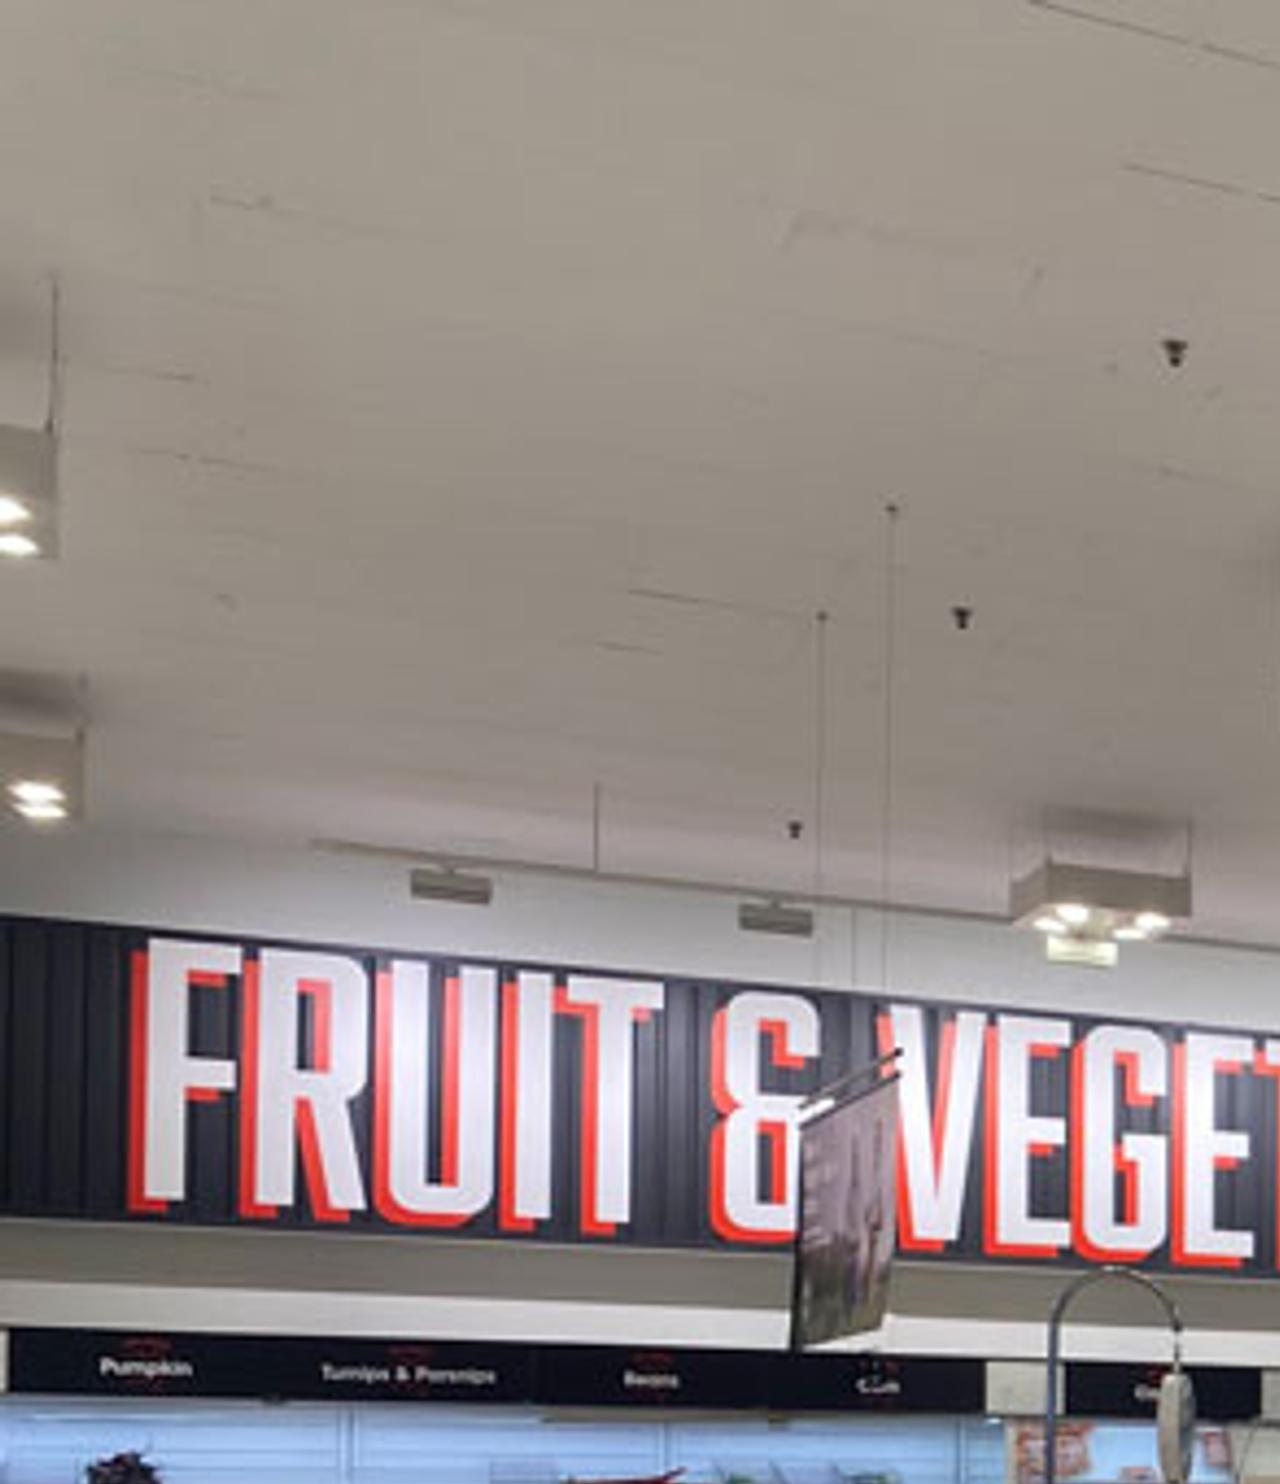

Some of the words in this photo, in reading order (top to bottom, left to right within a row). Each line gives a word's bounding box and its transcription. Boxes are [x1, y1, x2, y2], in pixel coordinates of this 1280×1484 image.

[130, 937, 664, 1232] FRUIT
[712, 991, 821, 1241] &
[100, 1356, 193, 1381] Pumpkin
[321, 1363, 390, 1384] Turnips
[396, 1365, 407, 1382] &
[414, 1365, 497, 1386] Parsnips
